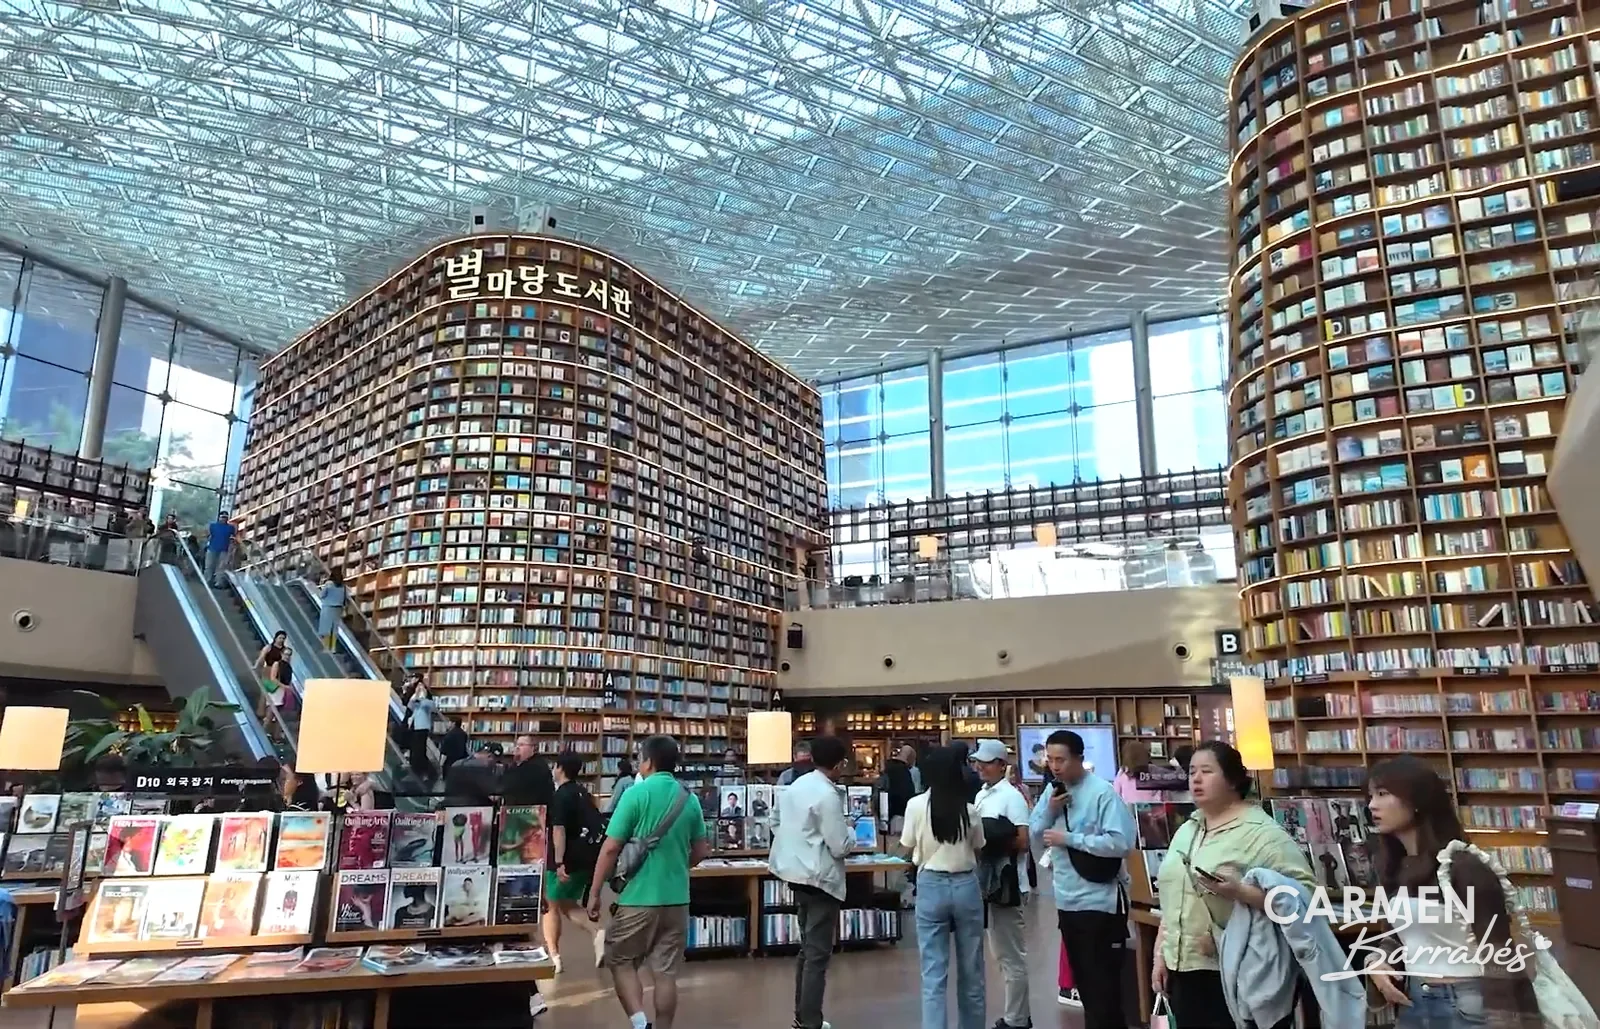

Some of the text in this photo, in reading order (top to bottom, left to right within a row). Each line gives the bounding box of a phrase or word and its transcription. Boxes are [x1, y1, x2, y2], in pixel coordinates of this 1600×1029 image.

[445, 248, 633, 319] 별마당도서관
[1221, 633, 1238, 653] B
[605, 672, 613, 686] A
[773, 690, 781, 701] A
[136, 776, 161, 787] D10
[166, 776, 214, 787] 외국잡지
[340, 874, 387, 883] DREAMS
[394, 871, 438, 881] DREAMS
